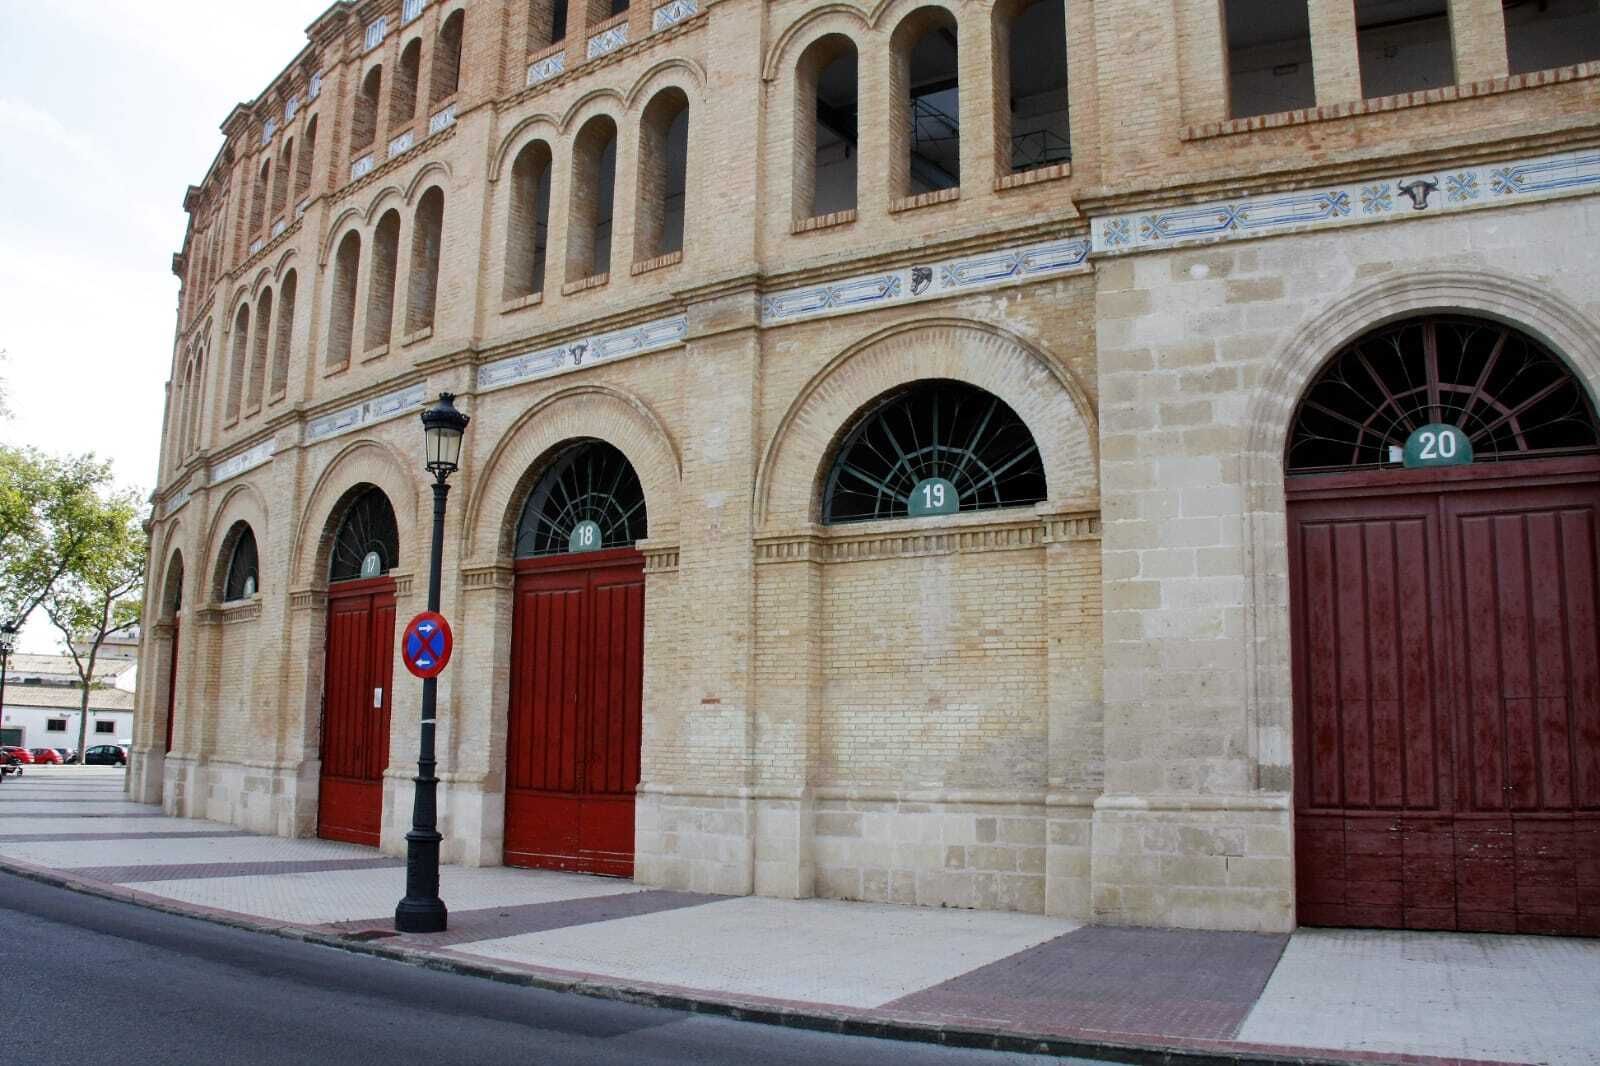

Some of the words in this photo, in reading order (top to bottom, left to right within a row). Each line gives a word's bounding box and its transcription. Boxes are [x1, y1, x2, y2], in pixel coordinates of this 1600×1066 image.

[1419, 430, 1456, 459] 20
[923, 484, 944, 508] 19
[579, 525, 593, 546] 18
[367, 555, 376, 573] 17
